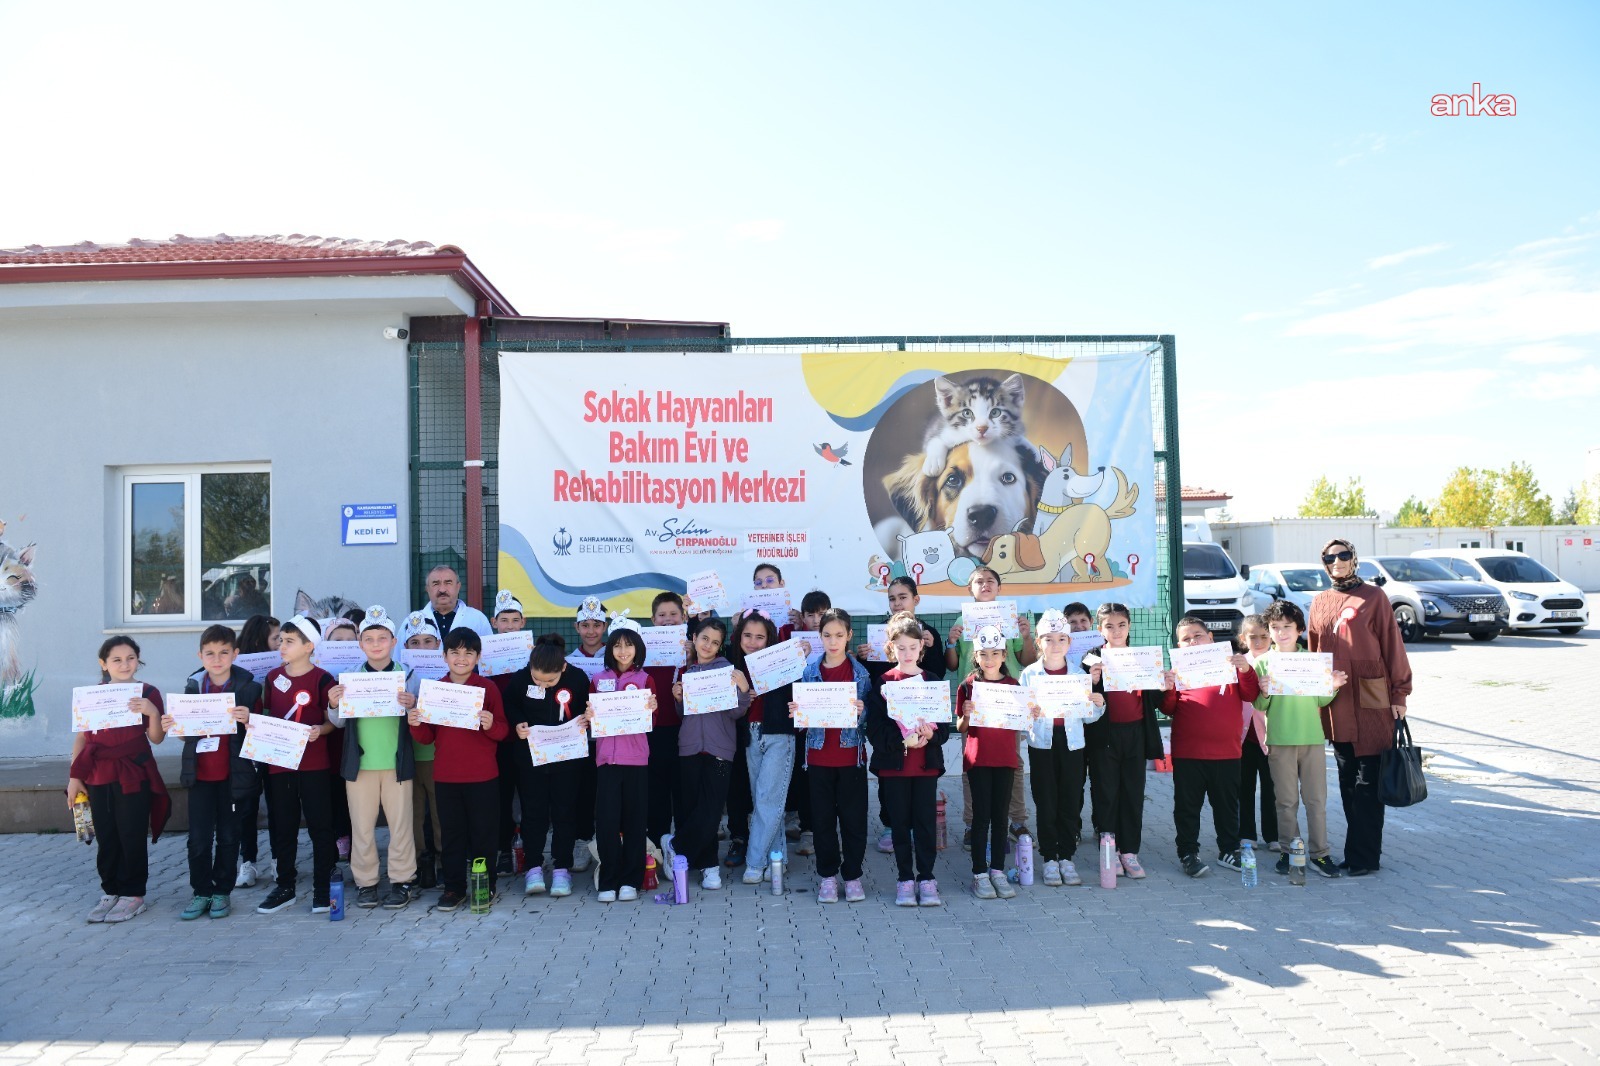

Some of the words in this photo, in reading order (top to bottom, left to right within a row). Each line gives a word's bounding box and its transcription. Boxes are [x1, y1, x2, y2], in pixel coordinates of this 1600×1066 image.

[583, 389, 652, 423] Sokak
[656, 389, 773, 428] Hayvanları
[609, 430, 679, 463] Bakım
[684, 430, 717, 463] Evi
[722, 437, 749, 463] ve
[554, 469, 716, 510] Rehabilitasyon
[722, 469, 806, 503] Merkezi
[376, 527, 389, 535] EVİ
[644, 528, 660, 537] Av.
[658, 517, 713, 543] Selim
[786, 530, 807, 545] İŞLERİ
[579, 544, 635, 554] BELEDİYESİ
[675, 535, 737, 549] ÇIRPANOĞLU
[756, 546, 799, 558] MÜDÜRLÜĞÜ
